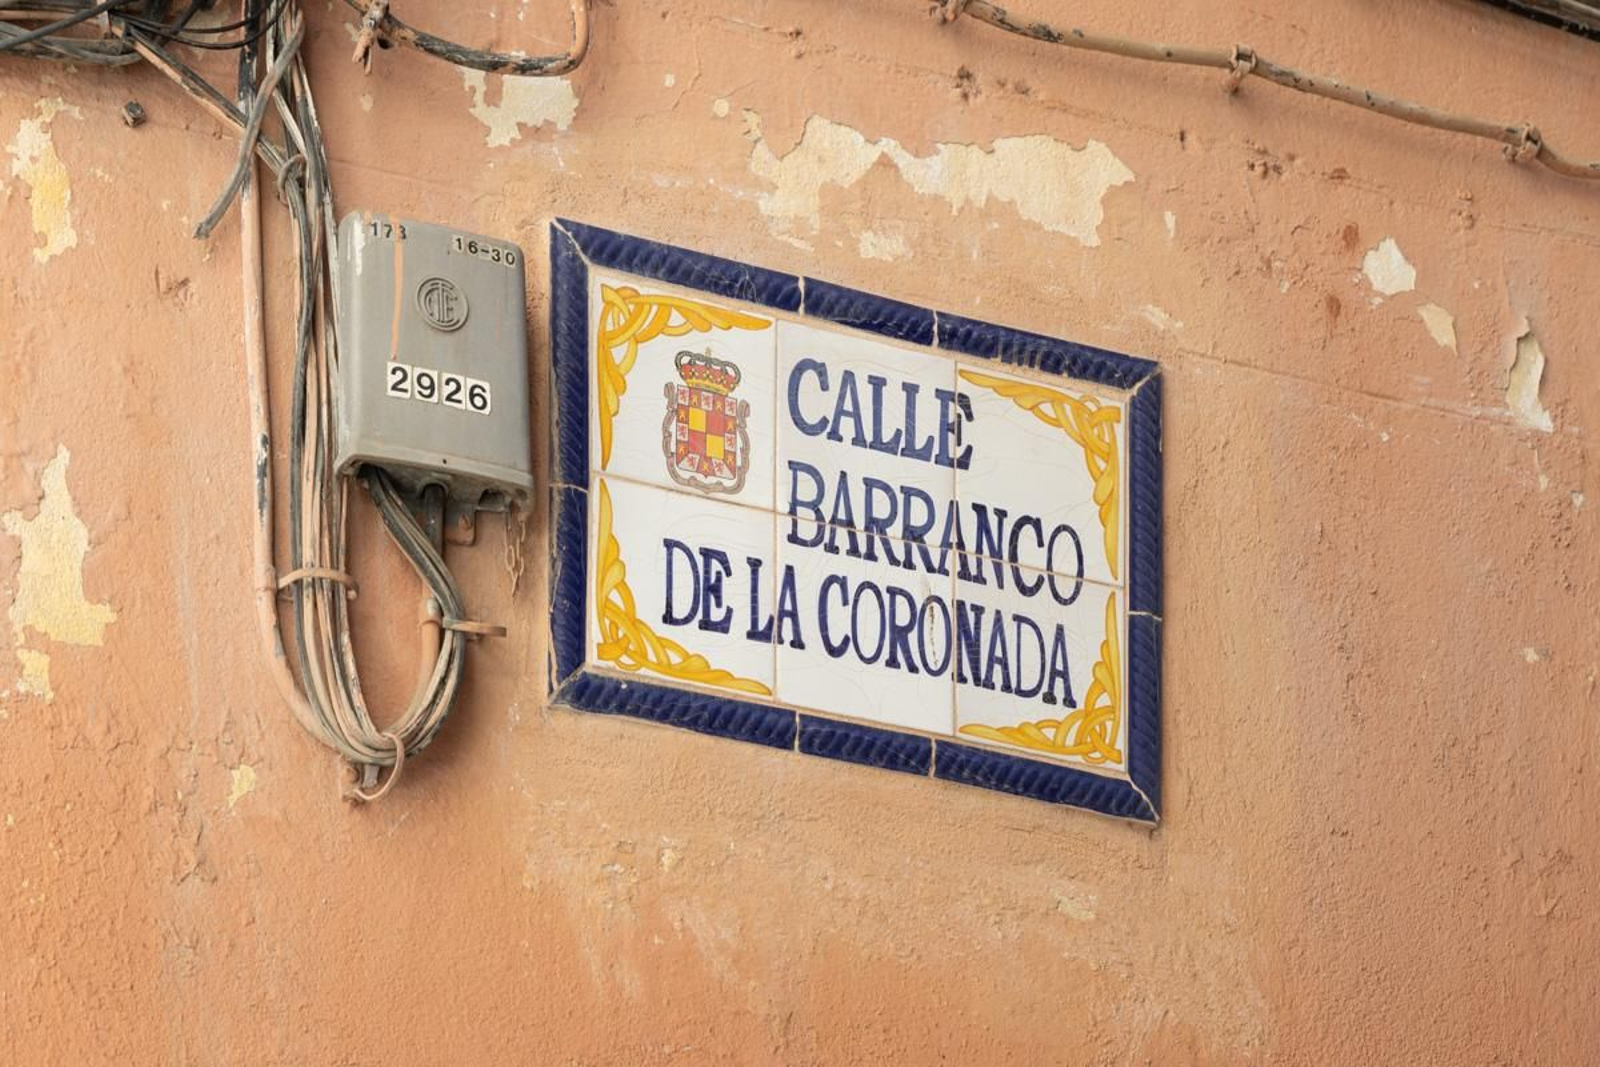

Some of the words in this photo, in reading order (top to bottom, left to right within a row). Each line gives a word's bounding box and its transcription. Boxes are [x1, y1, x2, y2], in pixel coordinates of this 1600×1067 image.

[456, 237, 516, 265] 16-30
[390, 365, 488, 411] 2926
[787, 357, 975, 470] CALLE
[787, 460, 1085, 607] BARRANCO
[661, 537, 734, 634] DE
[746, 556, 806, 650] LA
[817, 573, 1078, 709] CORONADA
